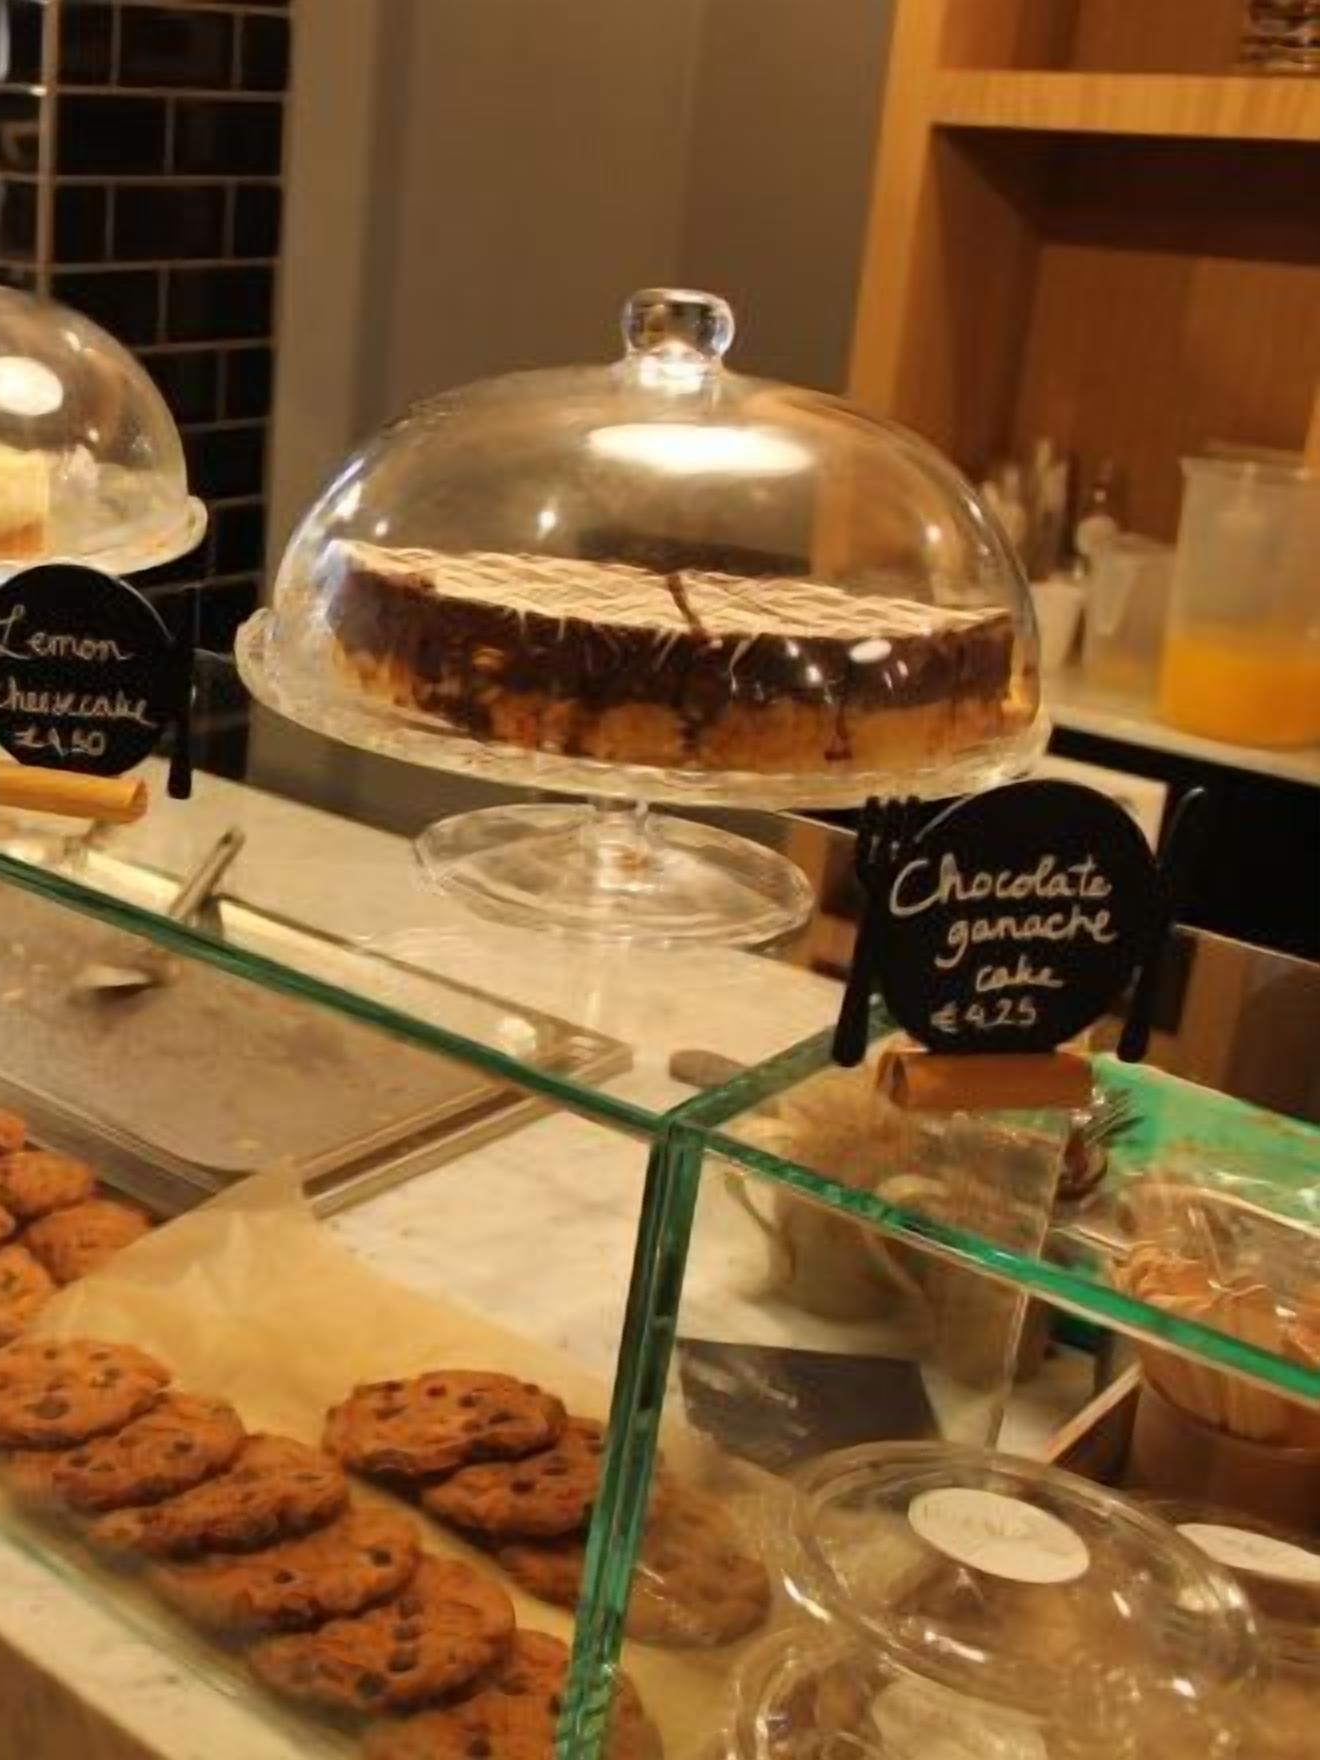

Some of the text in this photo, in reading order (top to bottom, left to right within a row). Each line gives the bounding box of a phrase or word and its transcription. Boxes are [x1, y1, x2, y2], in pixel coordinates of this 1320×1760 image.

[889, 852, 1113, 917] Chocolate
[935, 903, 1118, 968] ganache
[975, 955, 1064, 992] cake
